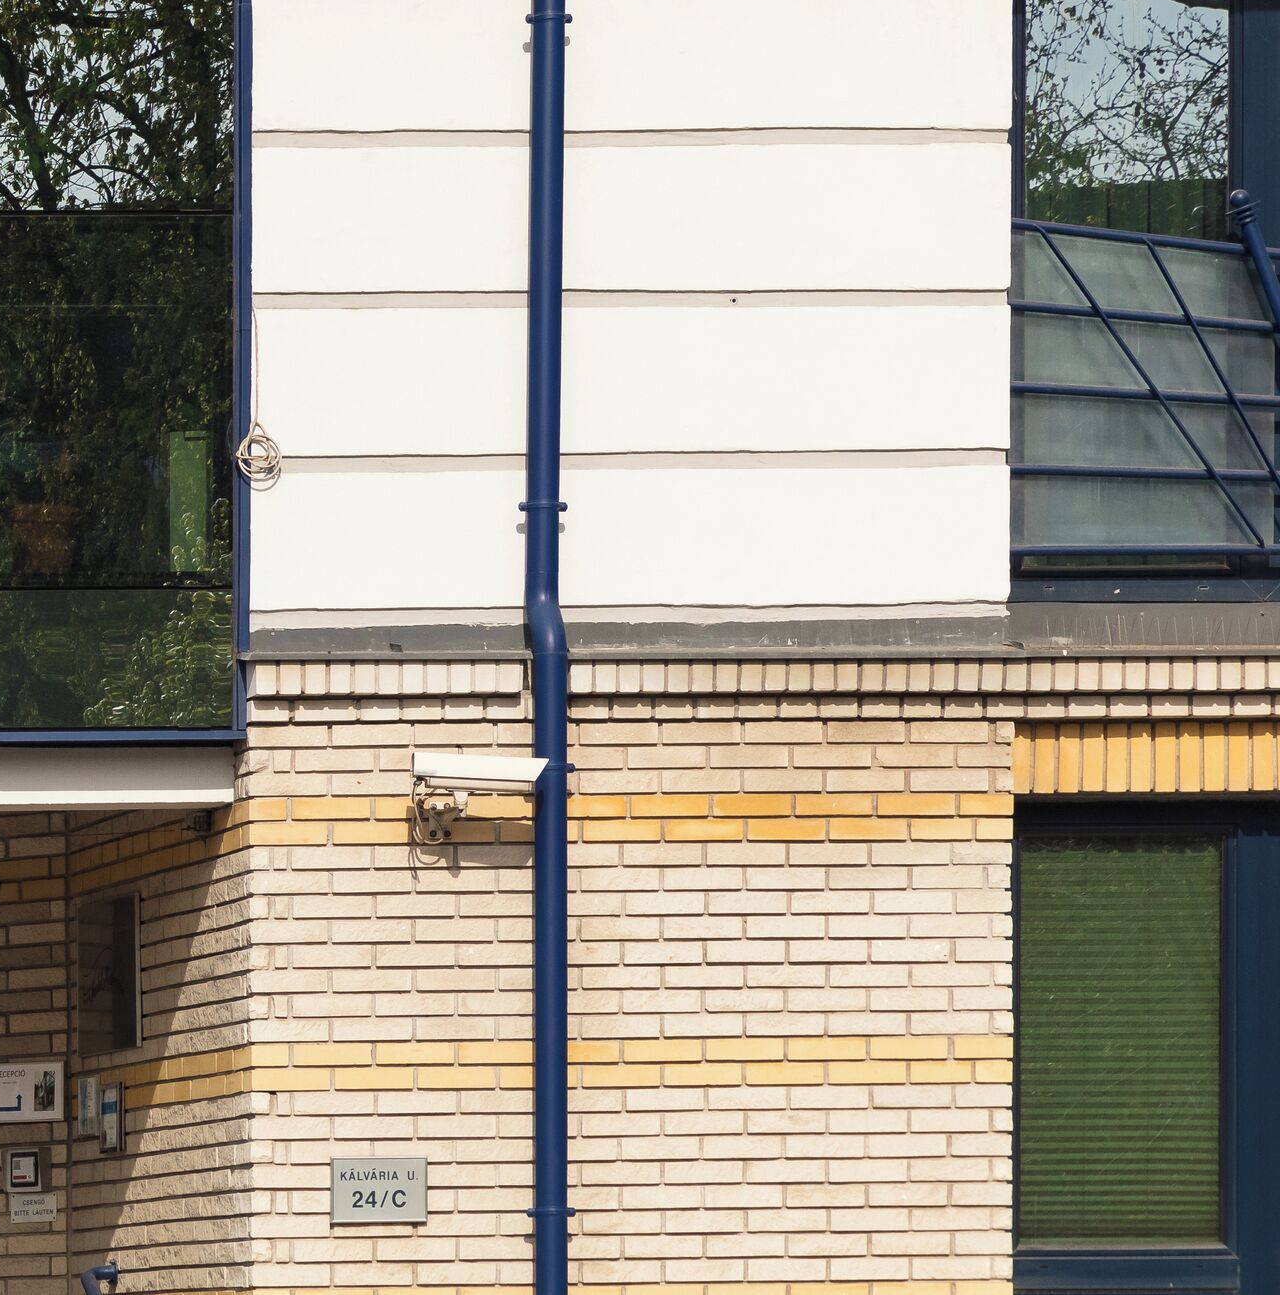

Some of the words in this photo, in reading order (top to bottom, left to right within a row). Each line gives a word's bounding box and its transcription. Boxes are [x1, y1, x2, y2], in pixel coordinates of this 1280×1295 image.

[340, 1168, 399, 1181] KÁLVÁRIA
[407, 1171, 419, 1181] U.
[352, 1190, 407, 1208] 24/C
